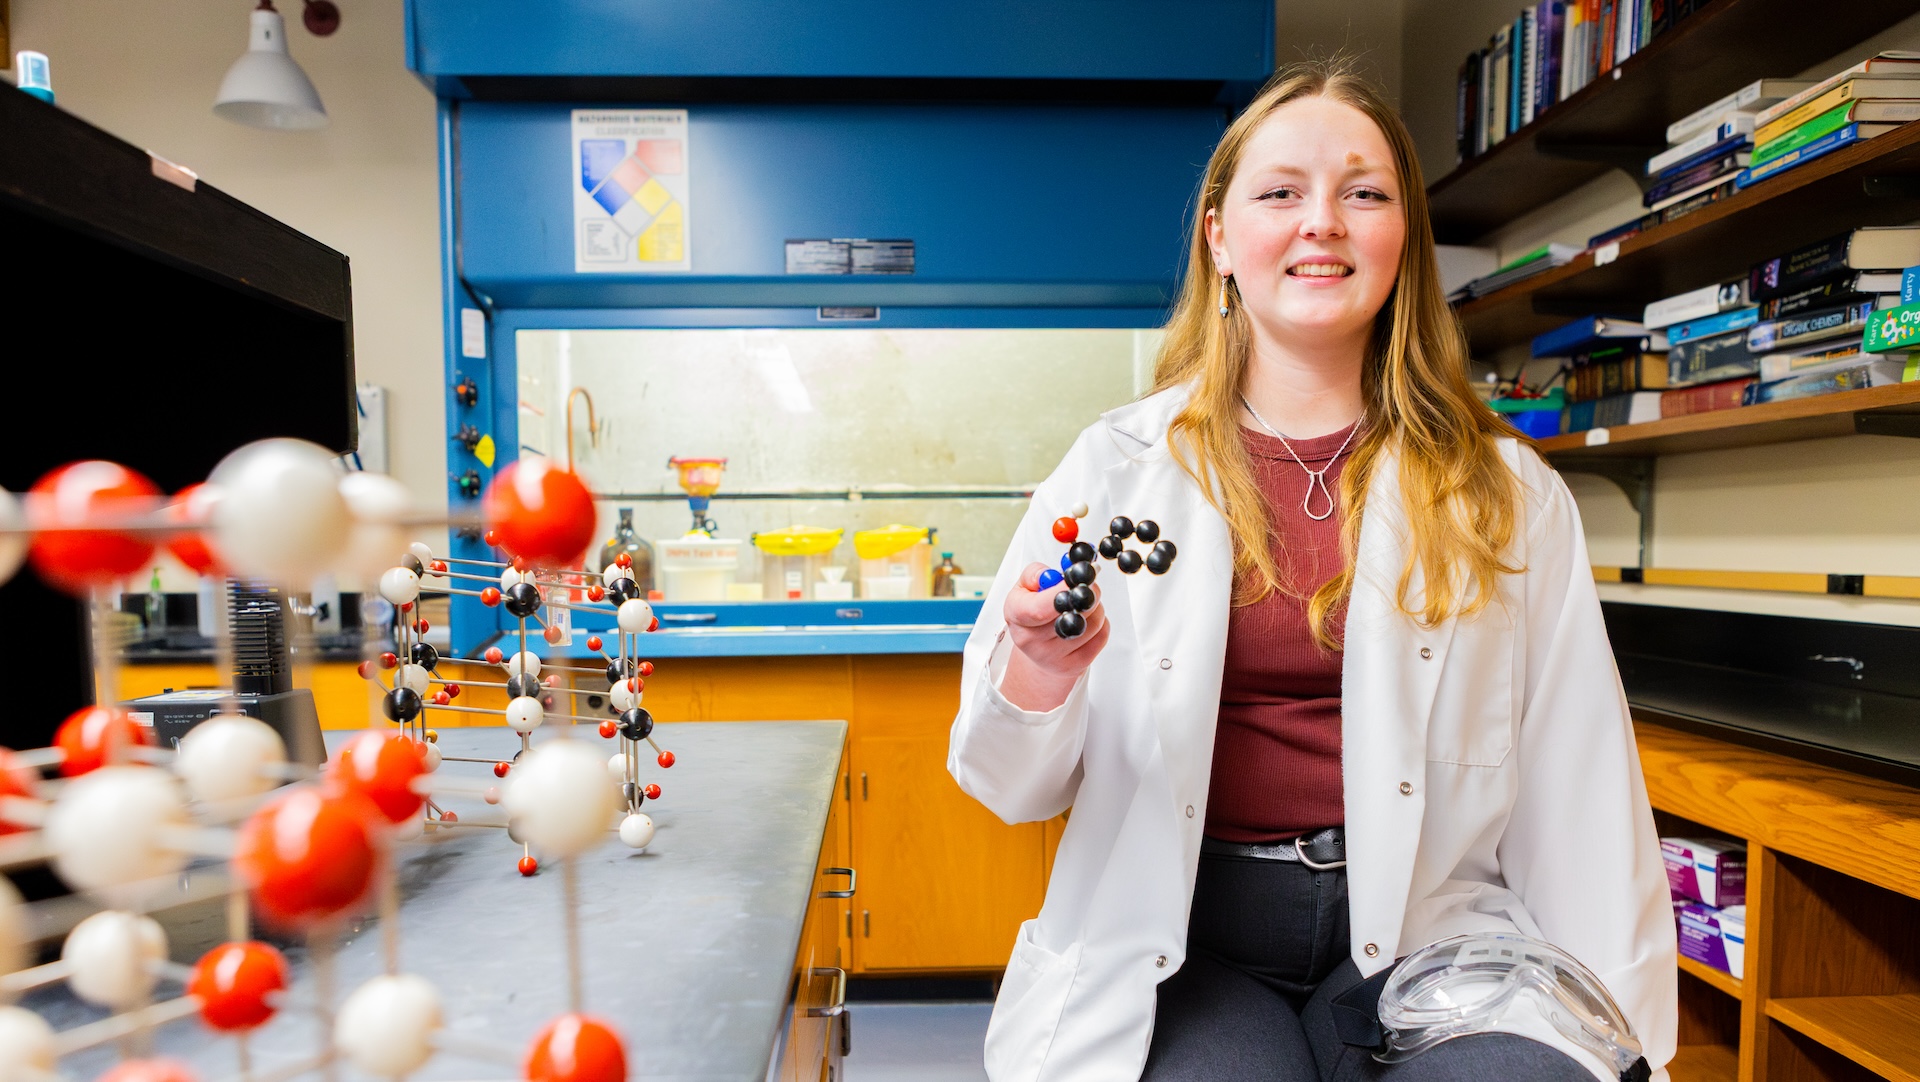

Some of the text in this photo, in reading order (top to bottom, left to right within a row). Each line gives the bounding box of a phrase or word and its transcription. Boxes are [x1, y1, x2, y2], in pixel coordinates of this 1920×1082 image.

[1905, 273, 1915, 302] Karty
[1783, 320, 1810, 337] ORGANIC
[1810, 313, 1845, 331] CHEMISTRY
[1869, 318, 1880, 345] Karty
